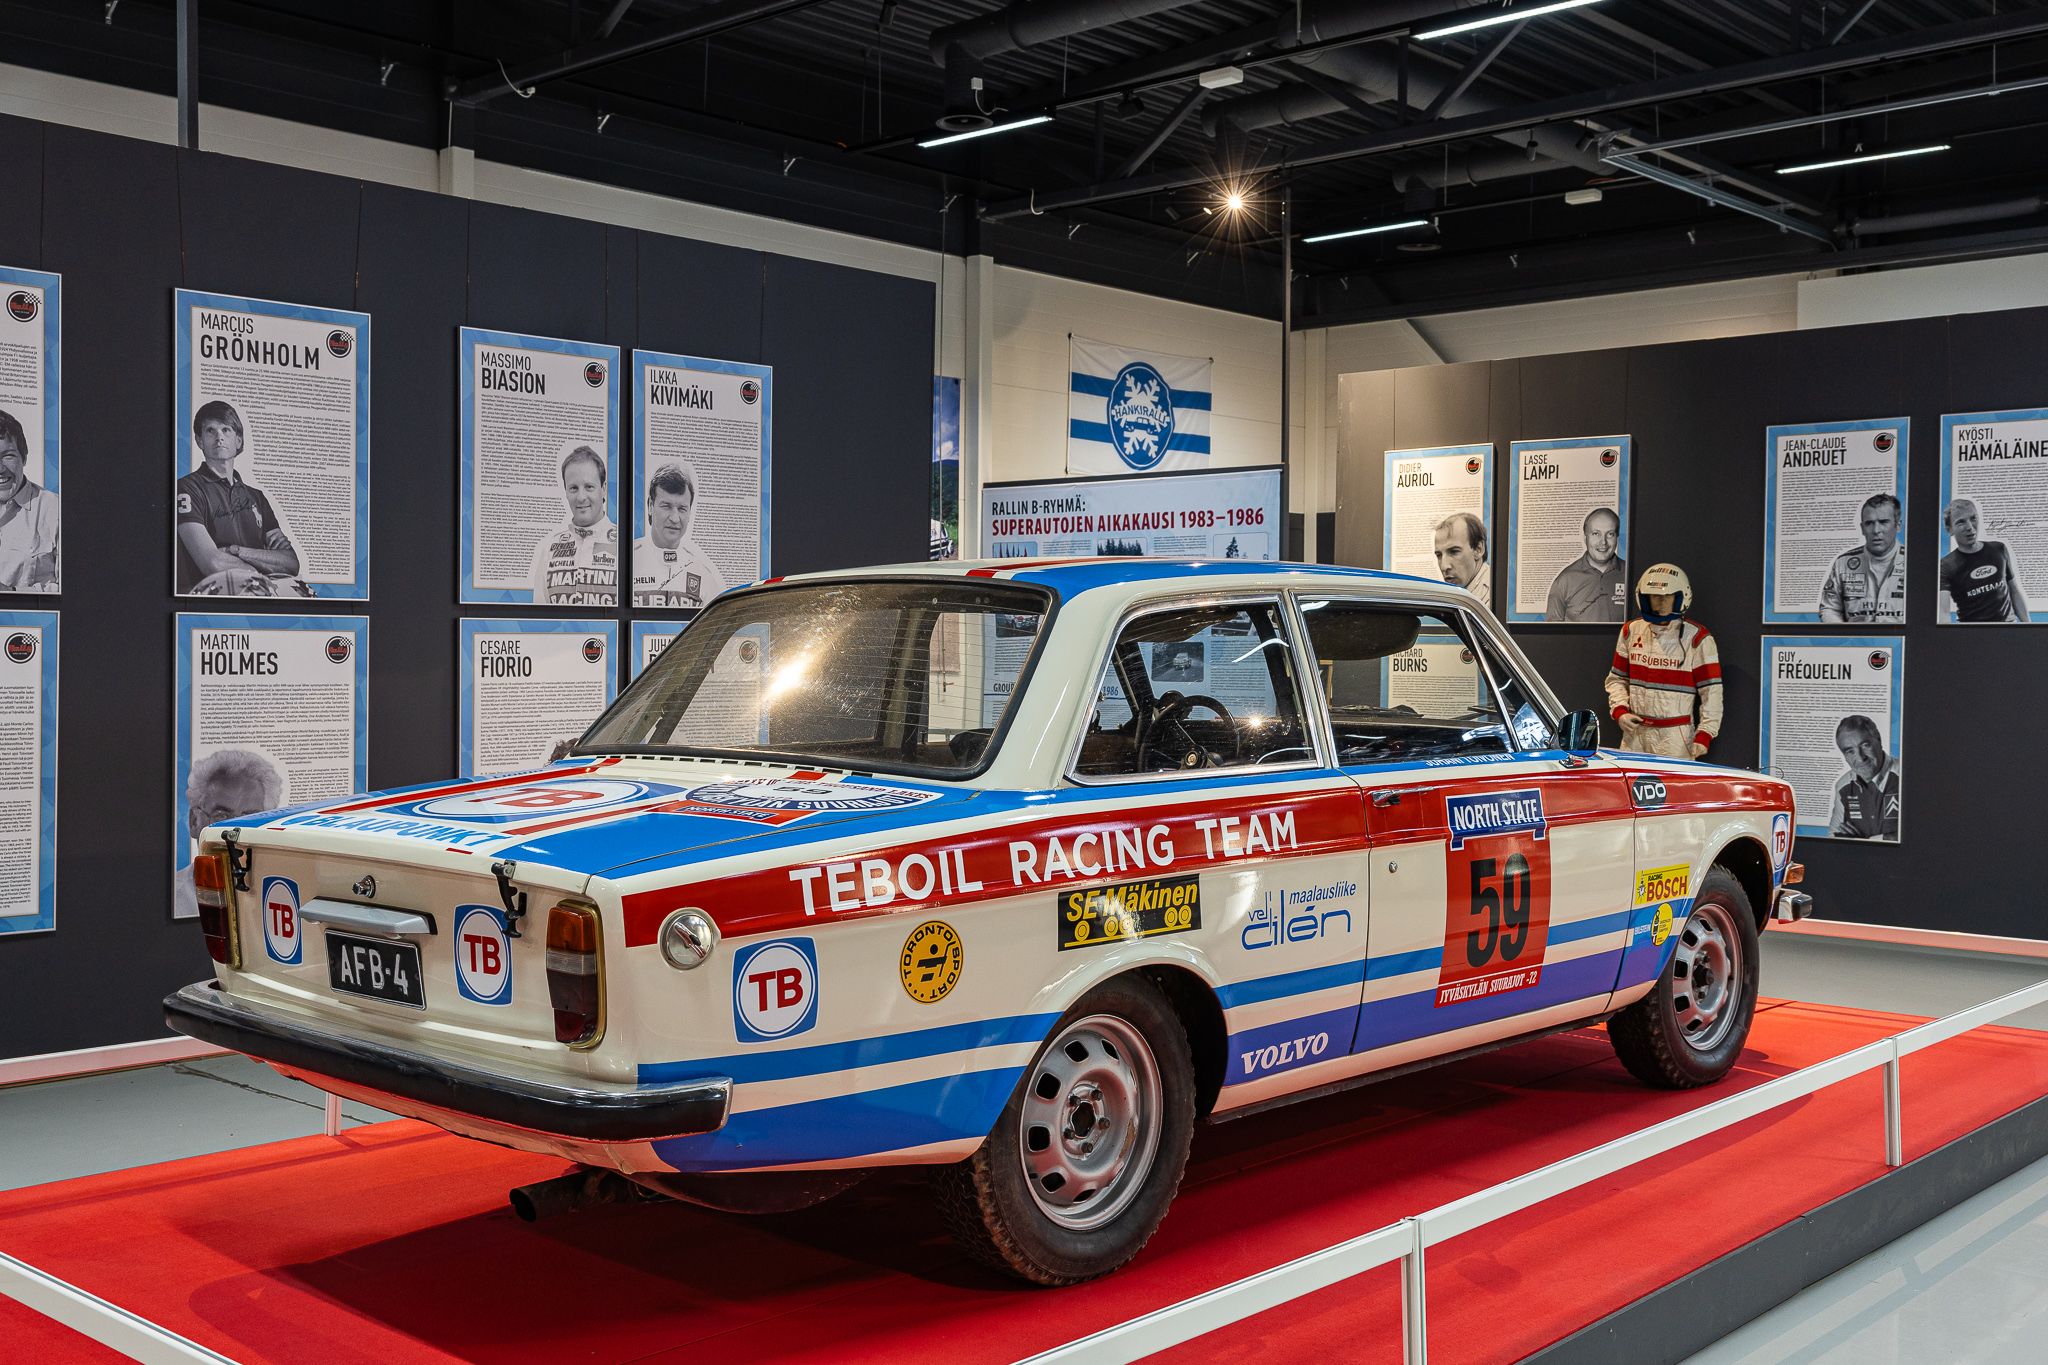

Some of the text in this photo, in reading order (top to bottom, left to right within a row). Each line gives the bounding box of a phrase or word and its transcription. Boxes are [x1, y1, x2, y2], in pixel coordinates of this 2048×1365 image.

[201, 312, 254, 334] MARCUS
[200, 333, 320, 370] GRÖNHOLM
[481, 351, 531, 371] MASSIMO
[481, 368, 546, 395] BIASION
[650, 369, 678, 385] ILKKA
[650, 384, 713, 410] KIVIMÄKI
[1114, 405, 1167, 426] HANKIRALLI
[1783, 437, 1846, 451] JEAN-CLAUDE
[1958, 426, 1993, 441] KYÖSTI
[1398, 463, 1422, 473] DIDIER
[1524, 454, 1548, 466] LASSE
[1782, 449, 1847, 468] ANDRUET
[1397, 472, 1435, 488] AURIOL
[1523, 464, 1559, 480] LAMPI
[991, 494, 1086, 516] RALLIN B-RYHMÄ:
[991, 515, 1094, 536] SUPERAUTOJEN
[1097, 511, 1175, 532] AIKAKAUSI
[550, 569, 615, 586] MARTINI
[1975, 567, 1992, 577] Ford
[200, 633, 250, 650] MARTIN
[480, 640, 521, 655] CESARE
[201, 652, 278, 675] HOLMES
[481, 655, 532, 678] FIORIO
[1393, 658, 1428, 673] BURNS
[1778, 651, 1796, 663] GUY
[1778, 660, 1852, 680] FRÉQUELIN
[1103, 686, 1119, 696] 1986
[1632, 781, 1667, 801] VDO
[1453, 798, 1540, 831] NORTH STATE
[308, 815, 514, 848] BLAUPUNKT
[1775, 830, 1786, 854] TB
[788, 810, 1299, 916] TEBOIL RACING TEAM
[1646, 875, 1688, 902] BOSCH
[1647, 873, 1663, 882] RACING
[1066, 882, 1198, 922] SE Mäkinen
[1289, 880, 1357, 905] maalausliike
[268, 901, 295, 939] TB
[1466, 853, 1531, 968] 59
[463, 933, 501, 975] TB
[340, 944, 409, 996] AFB-4
[748, 967, 804, 1012] TB
[1439, 978, 1489, 1004] JYVÄSKYLÄN
[1489, 973, 1526, 993] SUURAJOT
[1240, 1032, 1329, 1075] VOLVO
